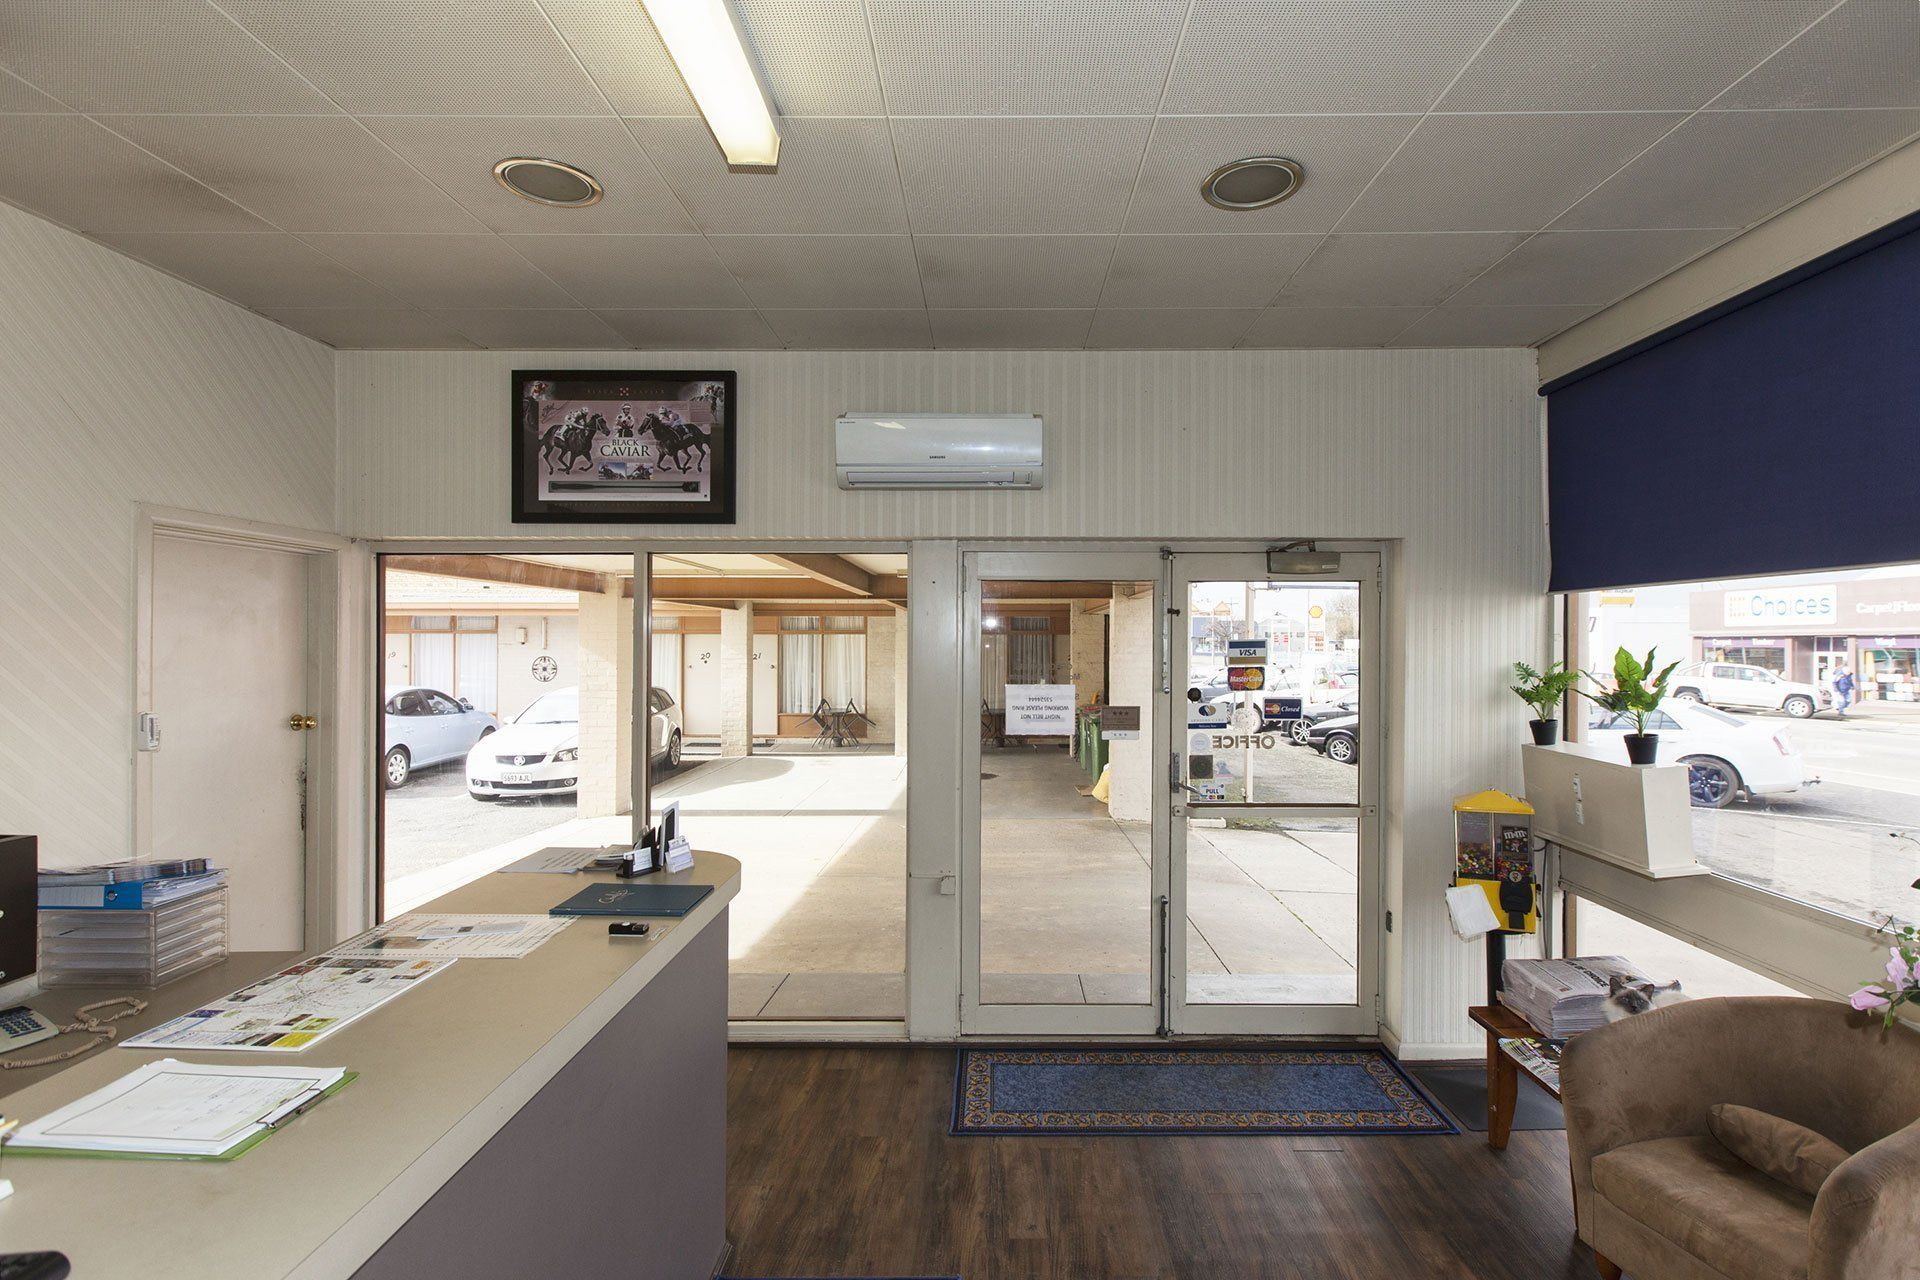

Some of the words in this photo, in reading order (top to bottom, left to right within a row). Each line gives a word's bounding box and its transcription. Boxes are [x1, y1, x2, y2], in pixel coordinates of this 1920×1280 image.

[600, 444, 651, 457] CAVIAR
[1751, 594, 1832, 617] Choices
[700, 652, 711, 660] 20
[753, 652, 762, 660] 21
[1239, 648, 1257, 656] VISA
[1229, 675, 1263, 683] MasterCard
